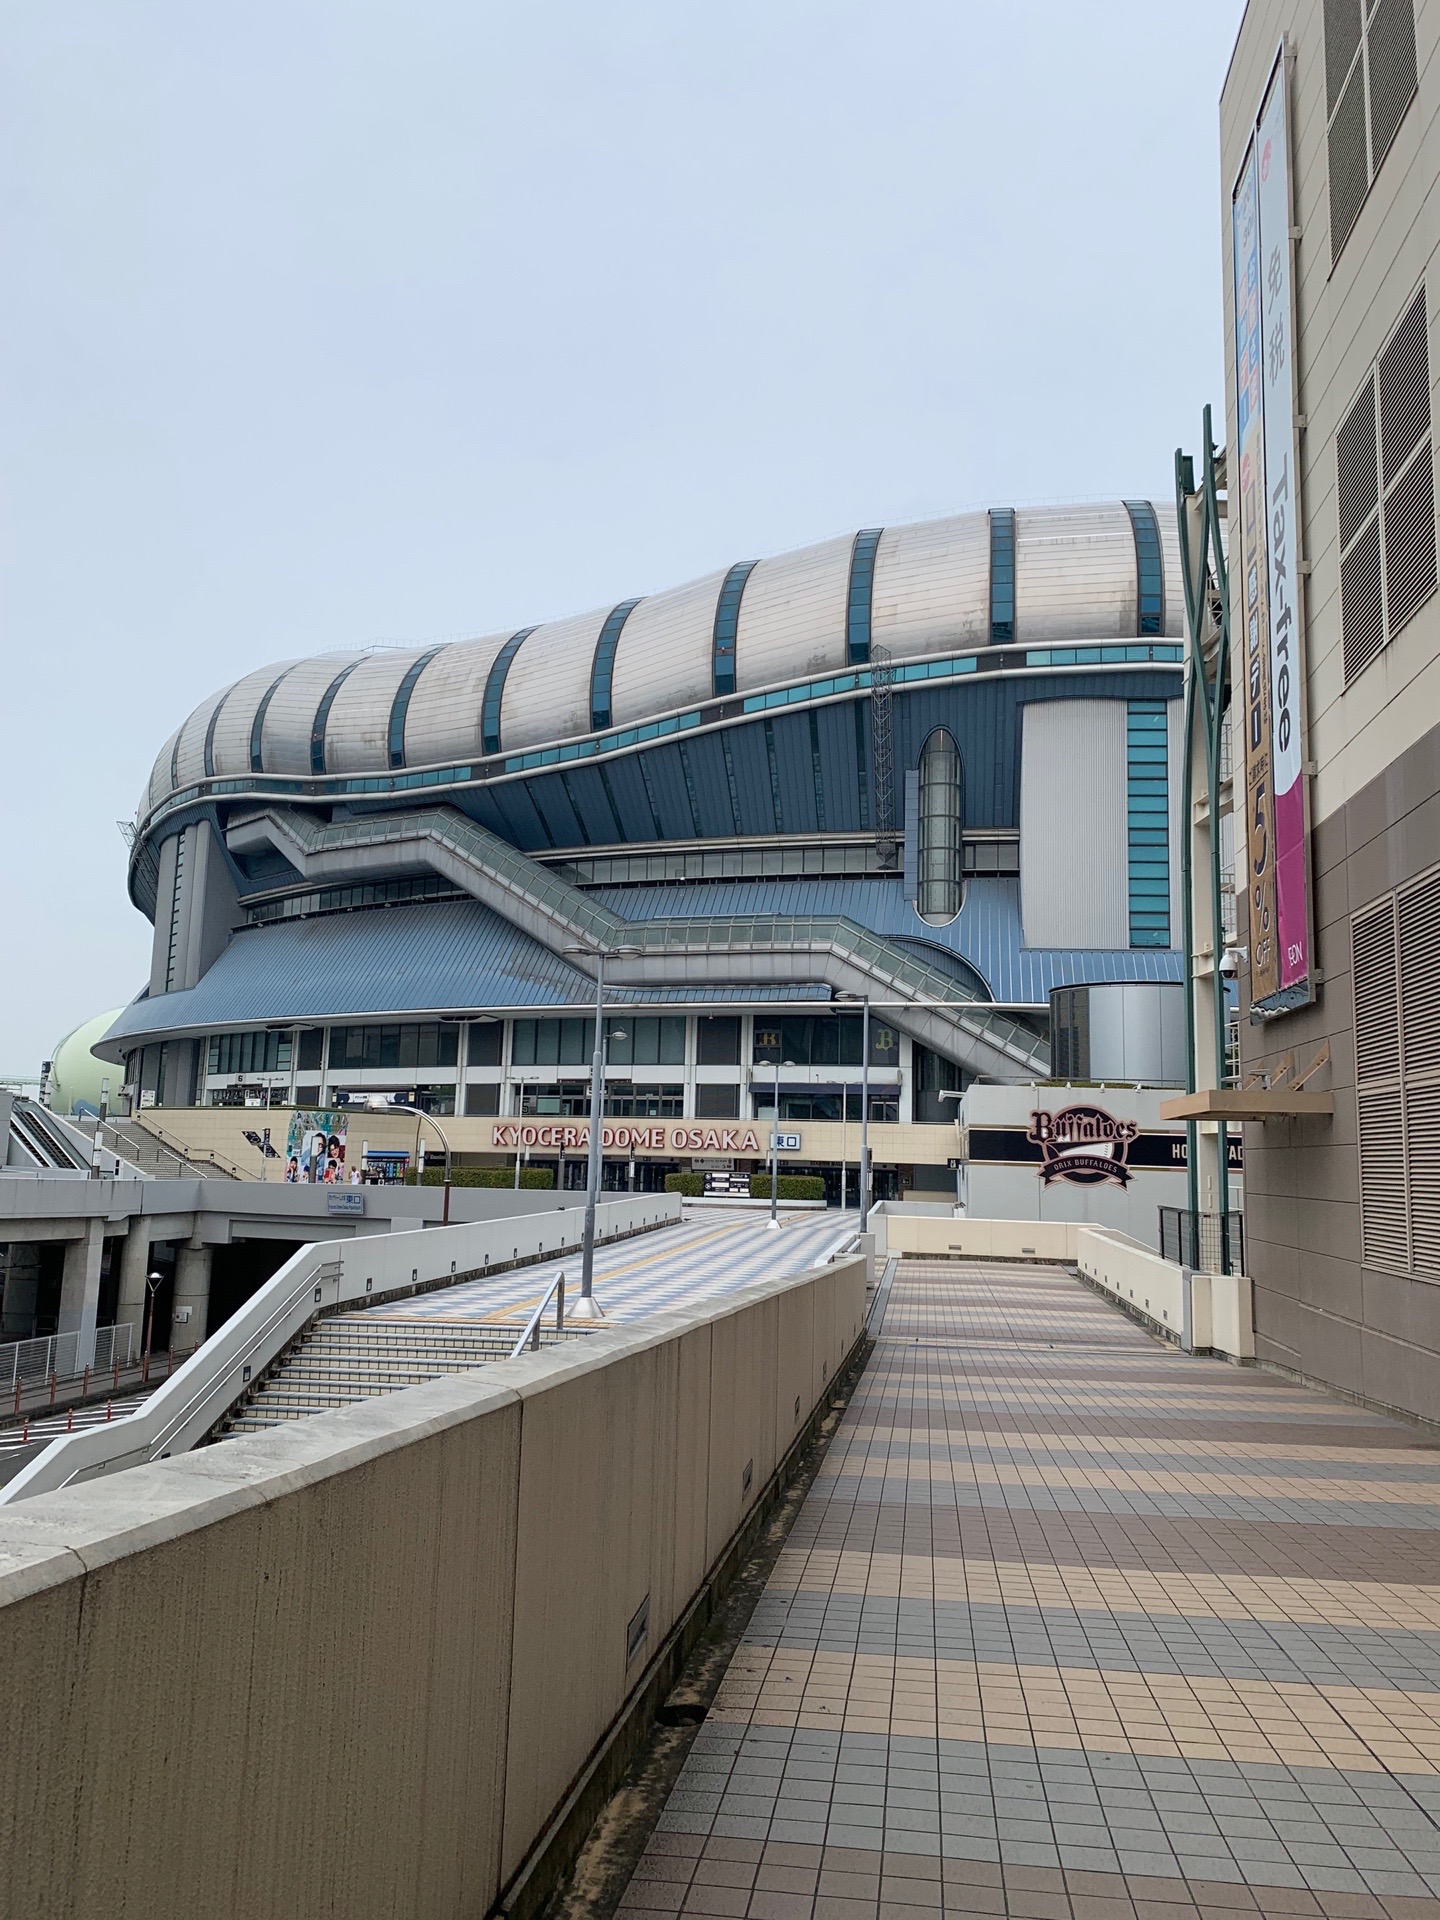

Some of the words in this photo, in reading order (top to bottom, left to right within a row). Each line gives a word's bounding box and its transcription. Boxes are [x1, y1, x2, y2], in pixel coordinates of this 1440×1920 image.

[1267, 244, 1285, 388] 免税
[1272, 451, 1291, 753] Tax-free
[1255, 937, 1271, 968] OFF
[493, 1126, 591, 1148] KYOCERA
[602, 1128, 665, 1149] DOME
[671, 1129, 760, 1151] OSAKA
[1029, 1111, 1138, 1142] Buffaloes
[1053, 1160, 1073, 1171] ORIX
[1074, 1158, 1118, 1173] BUFFALOES
[1172, 1143, 1188, 1159] HO
